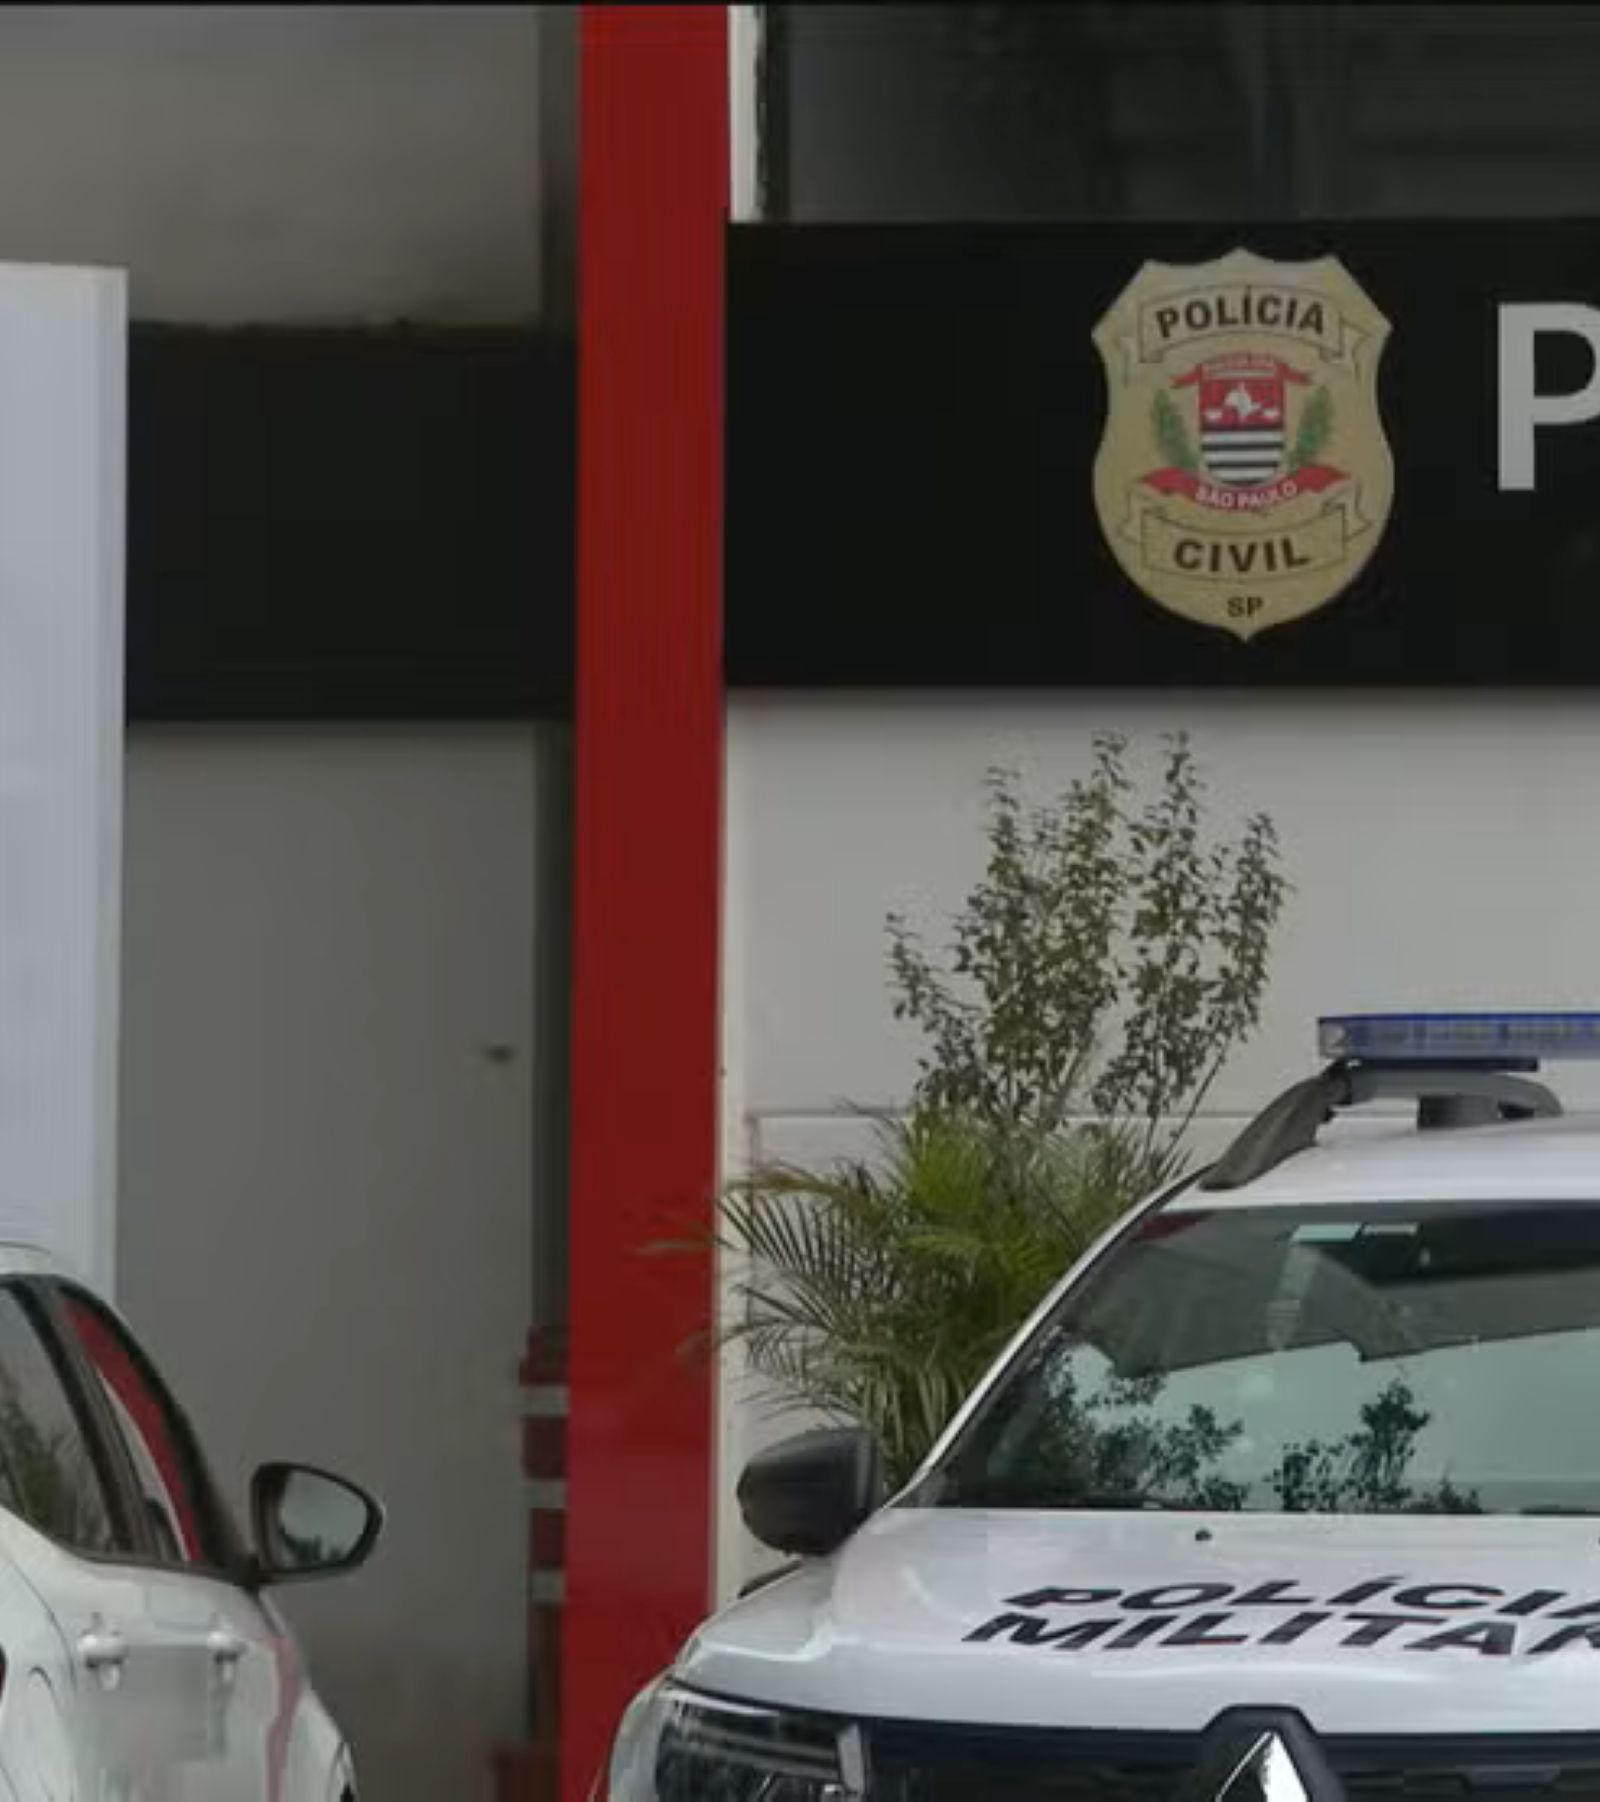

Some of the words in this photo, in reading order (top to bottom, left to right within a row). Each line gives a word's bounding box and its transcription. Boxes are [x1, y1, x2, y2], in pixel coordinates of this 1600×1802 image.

[1156, 286, 1325, 338] POLÍCIA
[1174, 537, 1310, 572] CIVIL
[1227, 597, 1264, 618] SP
